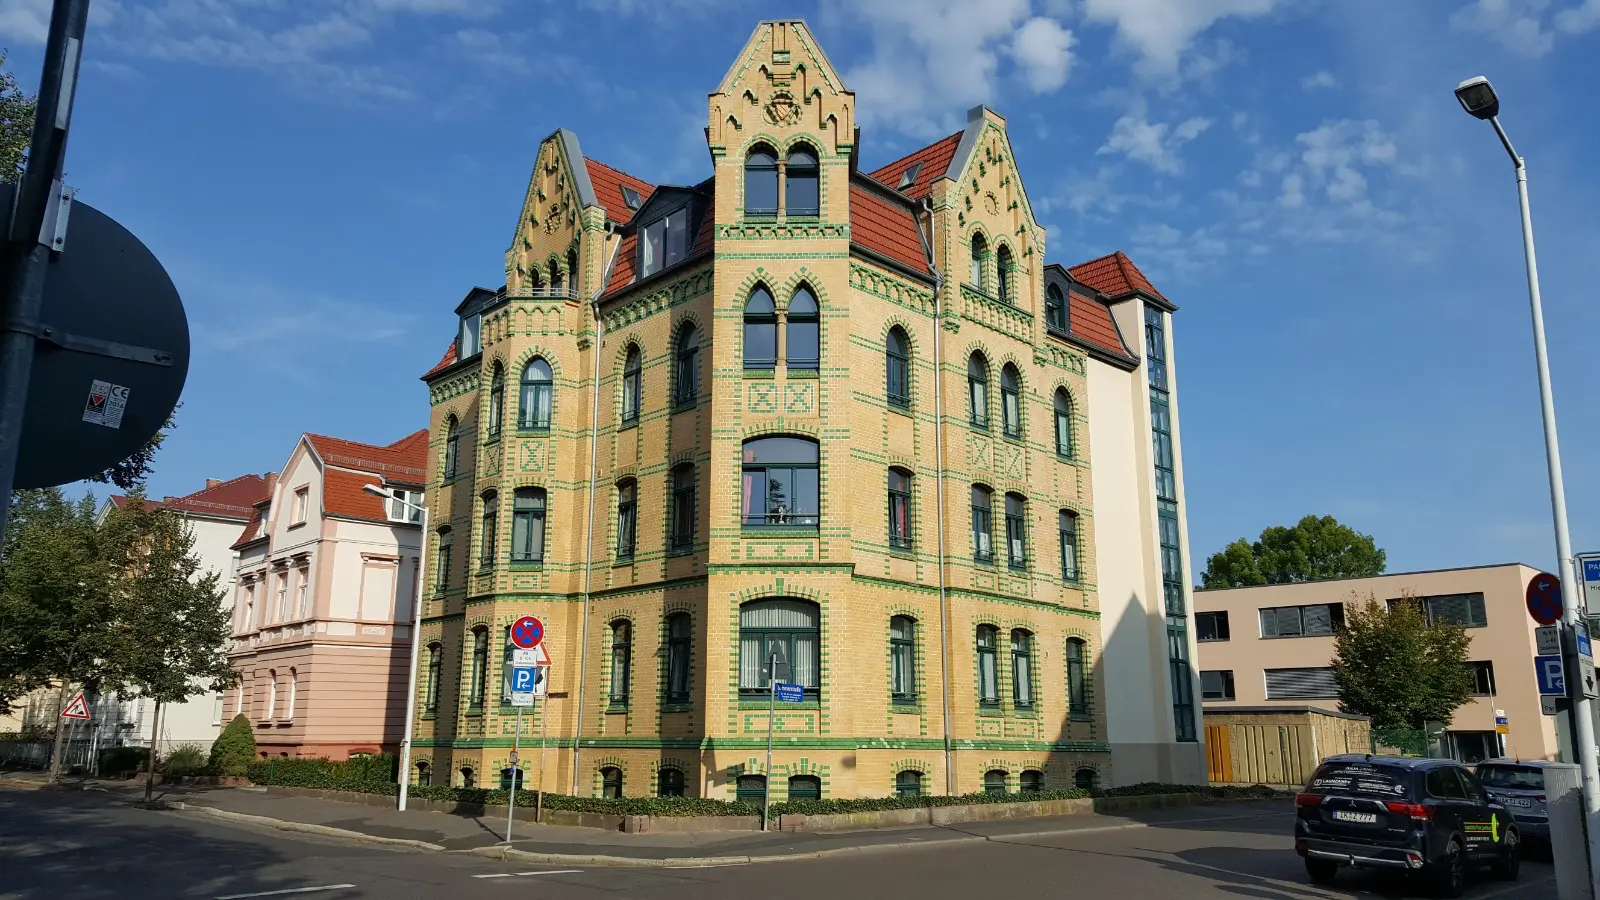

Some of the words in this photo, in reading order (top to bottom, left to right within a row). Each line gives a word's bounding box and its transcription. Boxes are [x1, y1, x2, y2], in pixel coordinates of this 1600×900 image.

[108, 401, 124, 409] 2016
[517, 670, 530, 689] P
[1544, 661, 1562, 689] P
[1353, 812, 1358, 820] Z
[1359, 813, 1373, 821] 777
